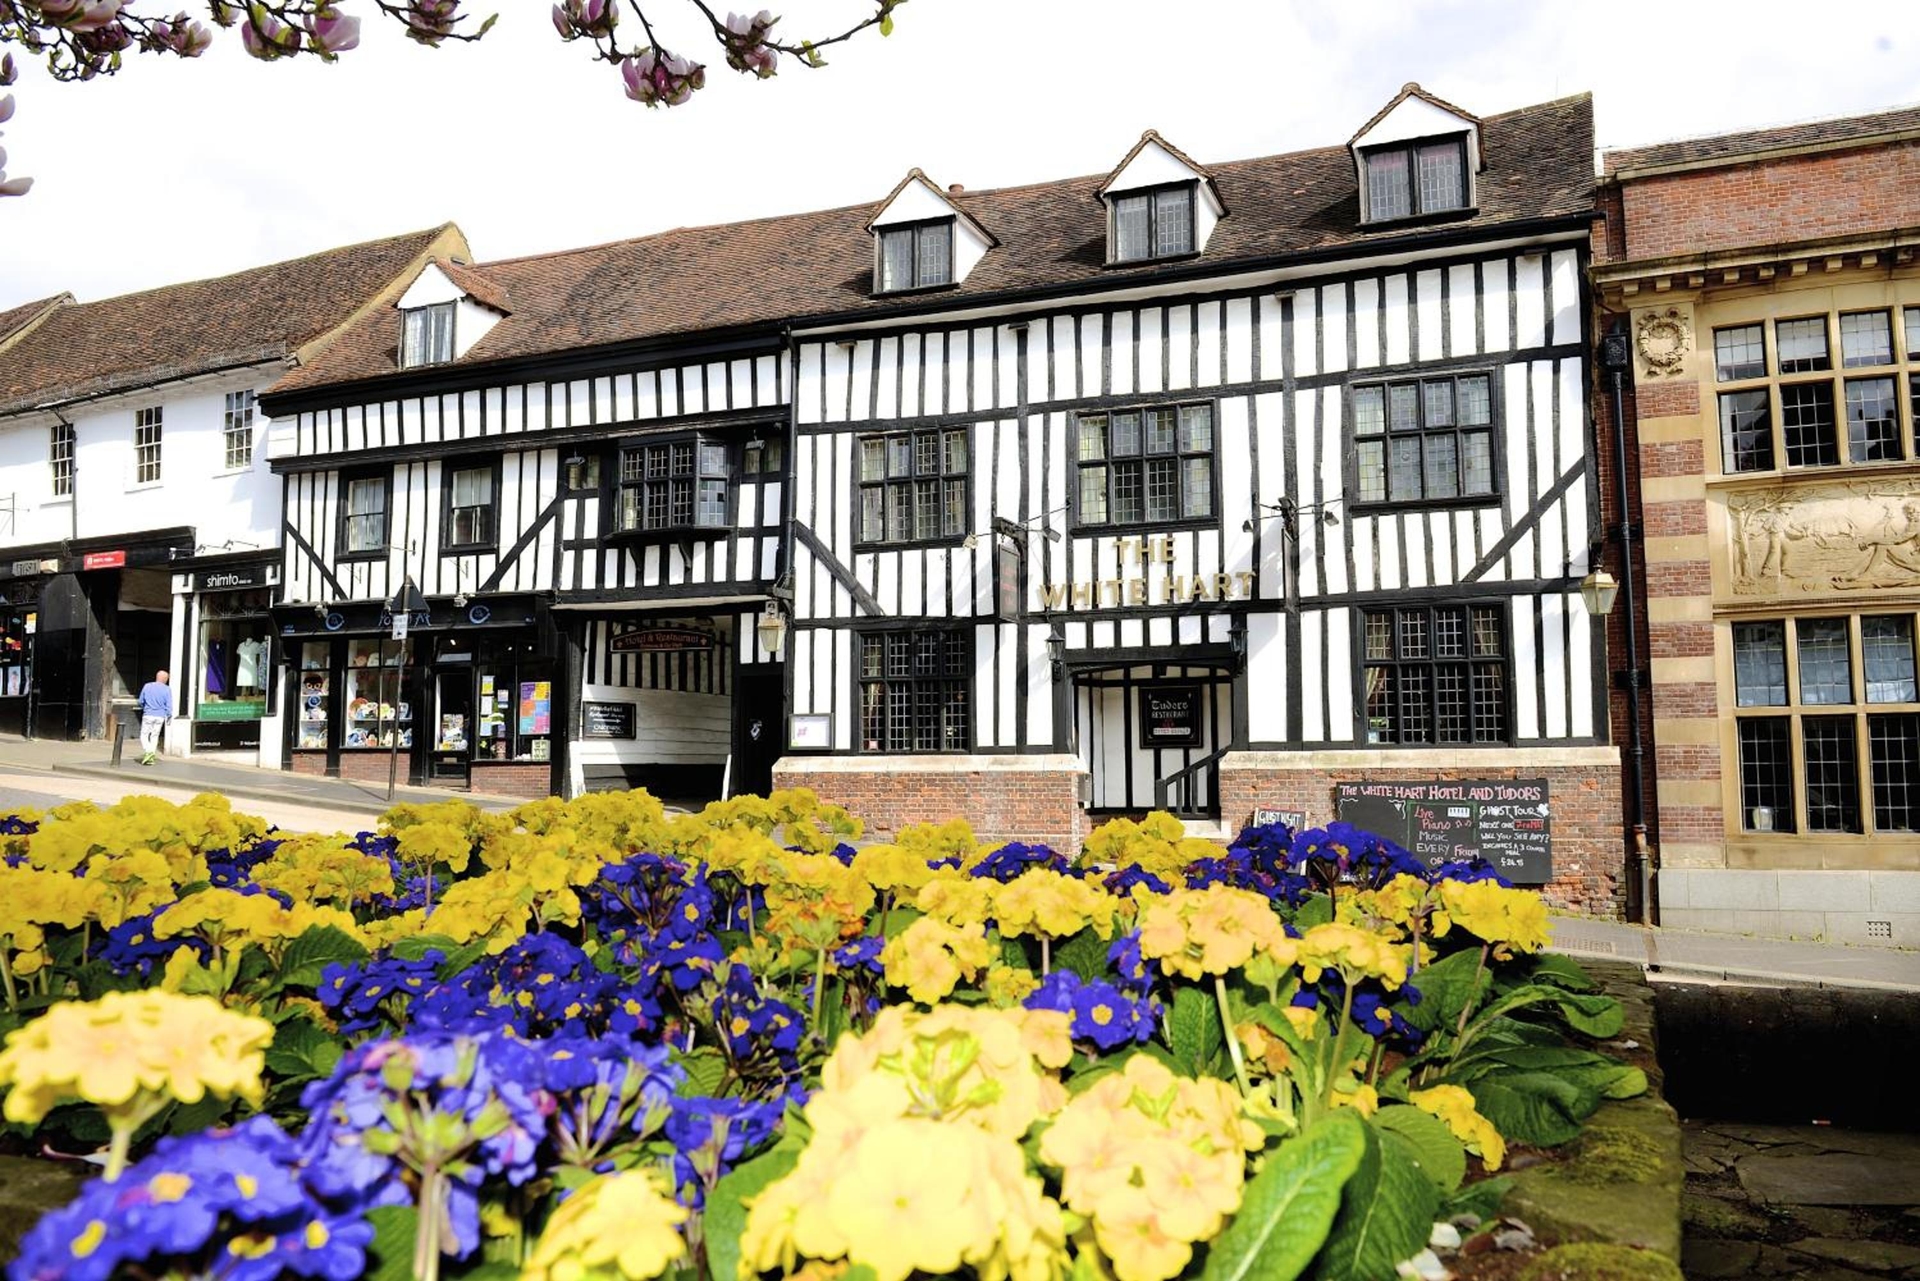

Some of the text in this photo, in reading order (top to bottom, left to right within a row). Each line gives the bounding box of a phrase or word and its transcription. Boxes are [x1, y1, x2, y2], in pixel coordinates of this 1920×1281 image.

[1114, 537, 1176, 565] THE
[1038, 577, 1148, 609] WHITE
[1161, 570, 1256, 601] HART
[1360, 785, 1393, 797] WHITE
[1394, 786, 1426, 799] HART
[1428, 785, 1466, 800] HOTEL
[1468, 786, 1494, 800] AND
[1495, 785, 1542, 801] TUDORS
[1414, 805, 1434, 819] Live
[1479, 805, 1512, 818] GHOST
[1422, 819, 1451, 830] Piano
[1416, 843, 1450, 856] EVERY
